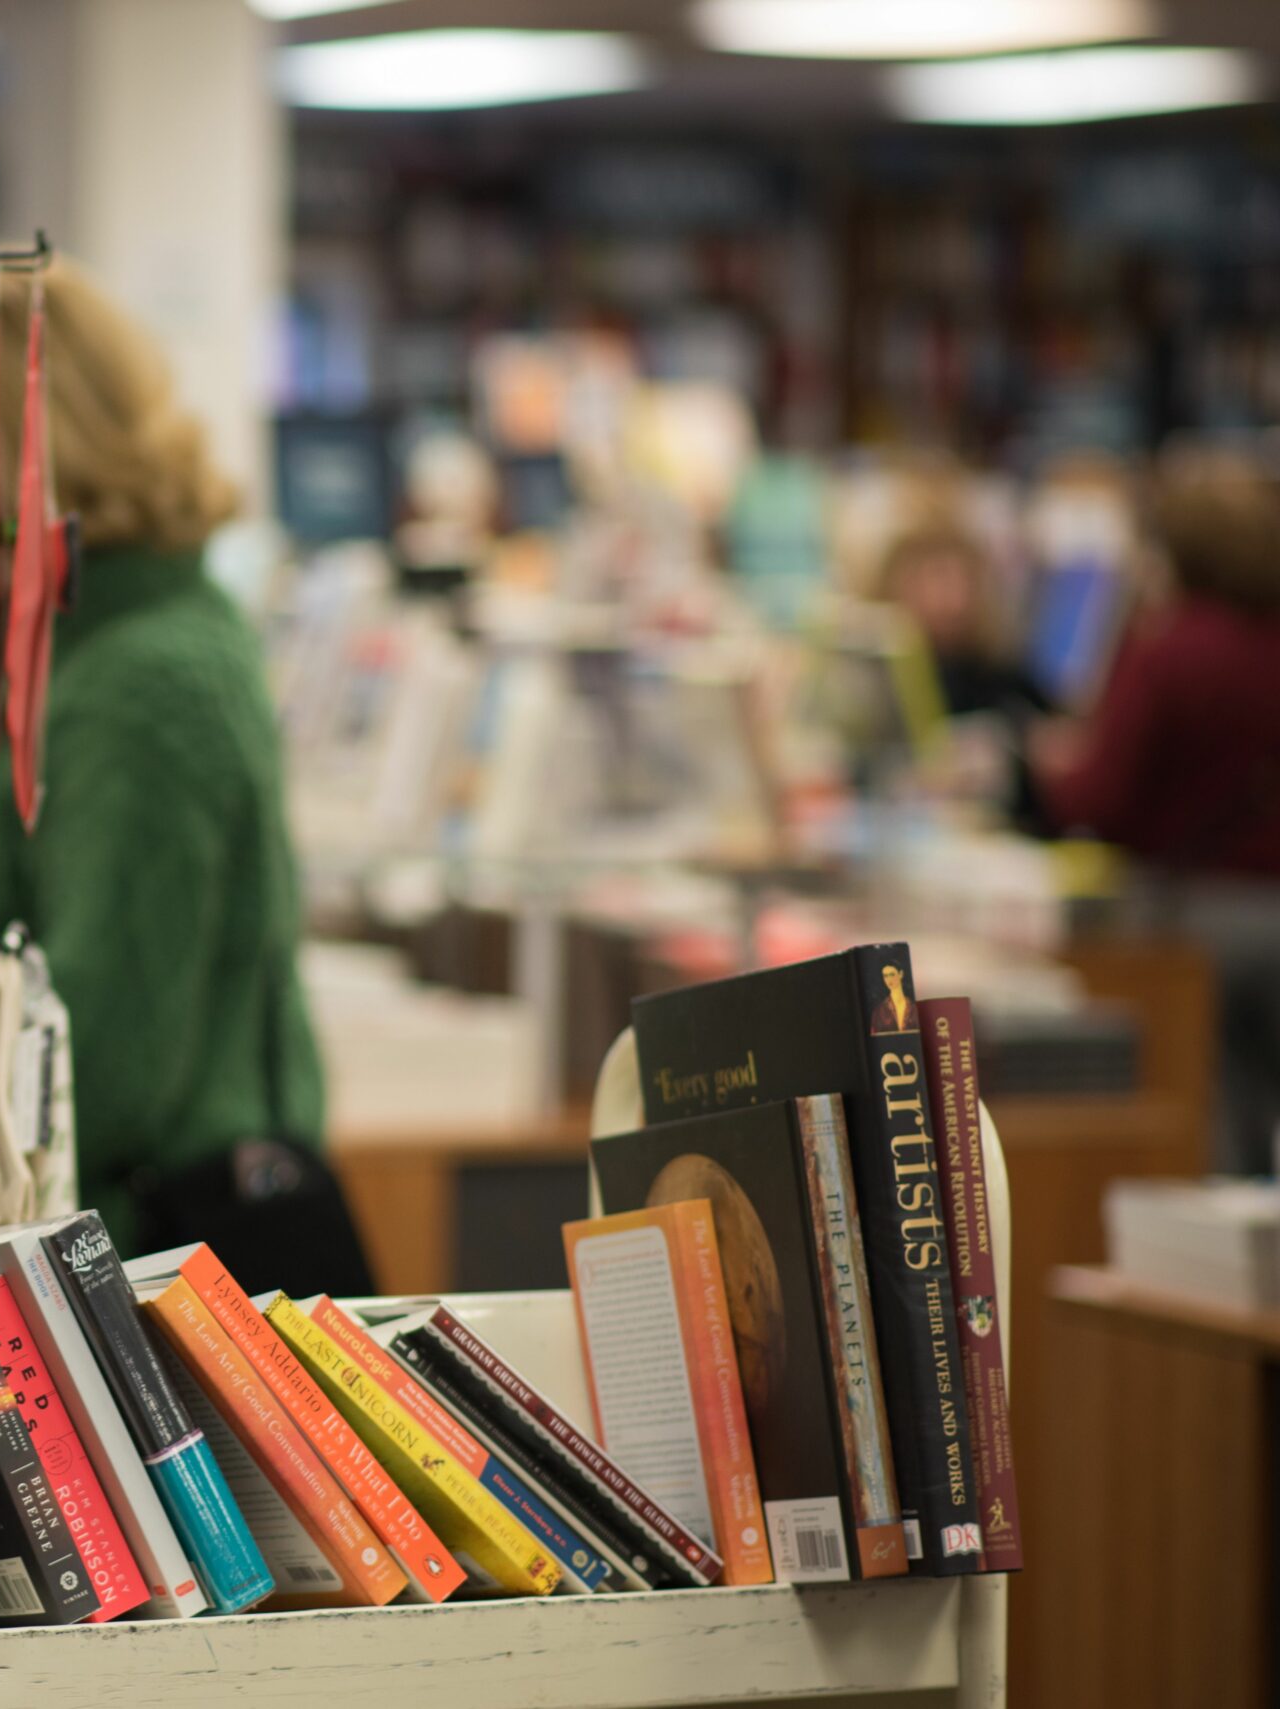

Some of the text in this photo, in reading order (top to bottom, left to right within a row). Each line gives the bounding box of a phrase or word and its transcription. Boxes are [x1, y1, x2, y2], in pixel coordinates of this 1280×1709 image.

[880, 1051, 943, 1271] artists
[935, 1016, 973, 1276] OF THE AMERICAN REVOLUTION
[958, 1038, 990, 1254] THE WEST POINT HISTORY
[317, 1307, 396, 1385] NeuroLogic
[825, 1191, 867, 1388] THE PLANETS
[7, 1337, 50, 1411] RED
[176, 1298, 331, 1500] The Lost Art of Good Conversation
[202, 1287, 212, 1298] A
[298, 1410, 324, 1441] LIFE
[334, 1457, 364, 1492] LOVE
[362, 1493, 386, 1521] AND
[384, 1522, 410, 1552] WAR
[208, 1272, 268, 1341] Lynsey
[261, 1336, 328, 1415] Addario
[319, 1411, 352, 1446] It's
[343, 1441, 392, 1497] What
[385, 1494, 402, 1510] I
[395, 1507, 428, 1543] Do
[283, 1310, 422, 1452] THE LAST UNICORN
[449, 1325, 533, 1404] GRAHAM GREENE
[923, 1278, 967, 1505] THEIR LIVES AND WORKS
[14, 1480, 54, 1554] GREENE
[28, 1475, 60, 1530] BRIAN
[70, 1477, 131, 1595] KIM STANLEY
[443, 1473, 525, 1556] PETER BEAGLE
[548, 1416, 678, 1539] THE POWER AND THE GLORY
[943, 1524, 977, 1553] DK
[55, 1484, 117, 1604] ROBINSON
